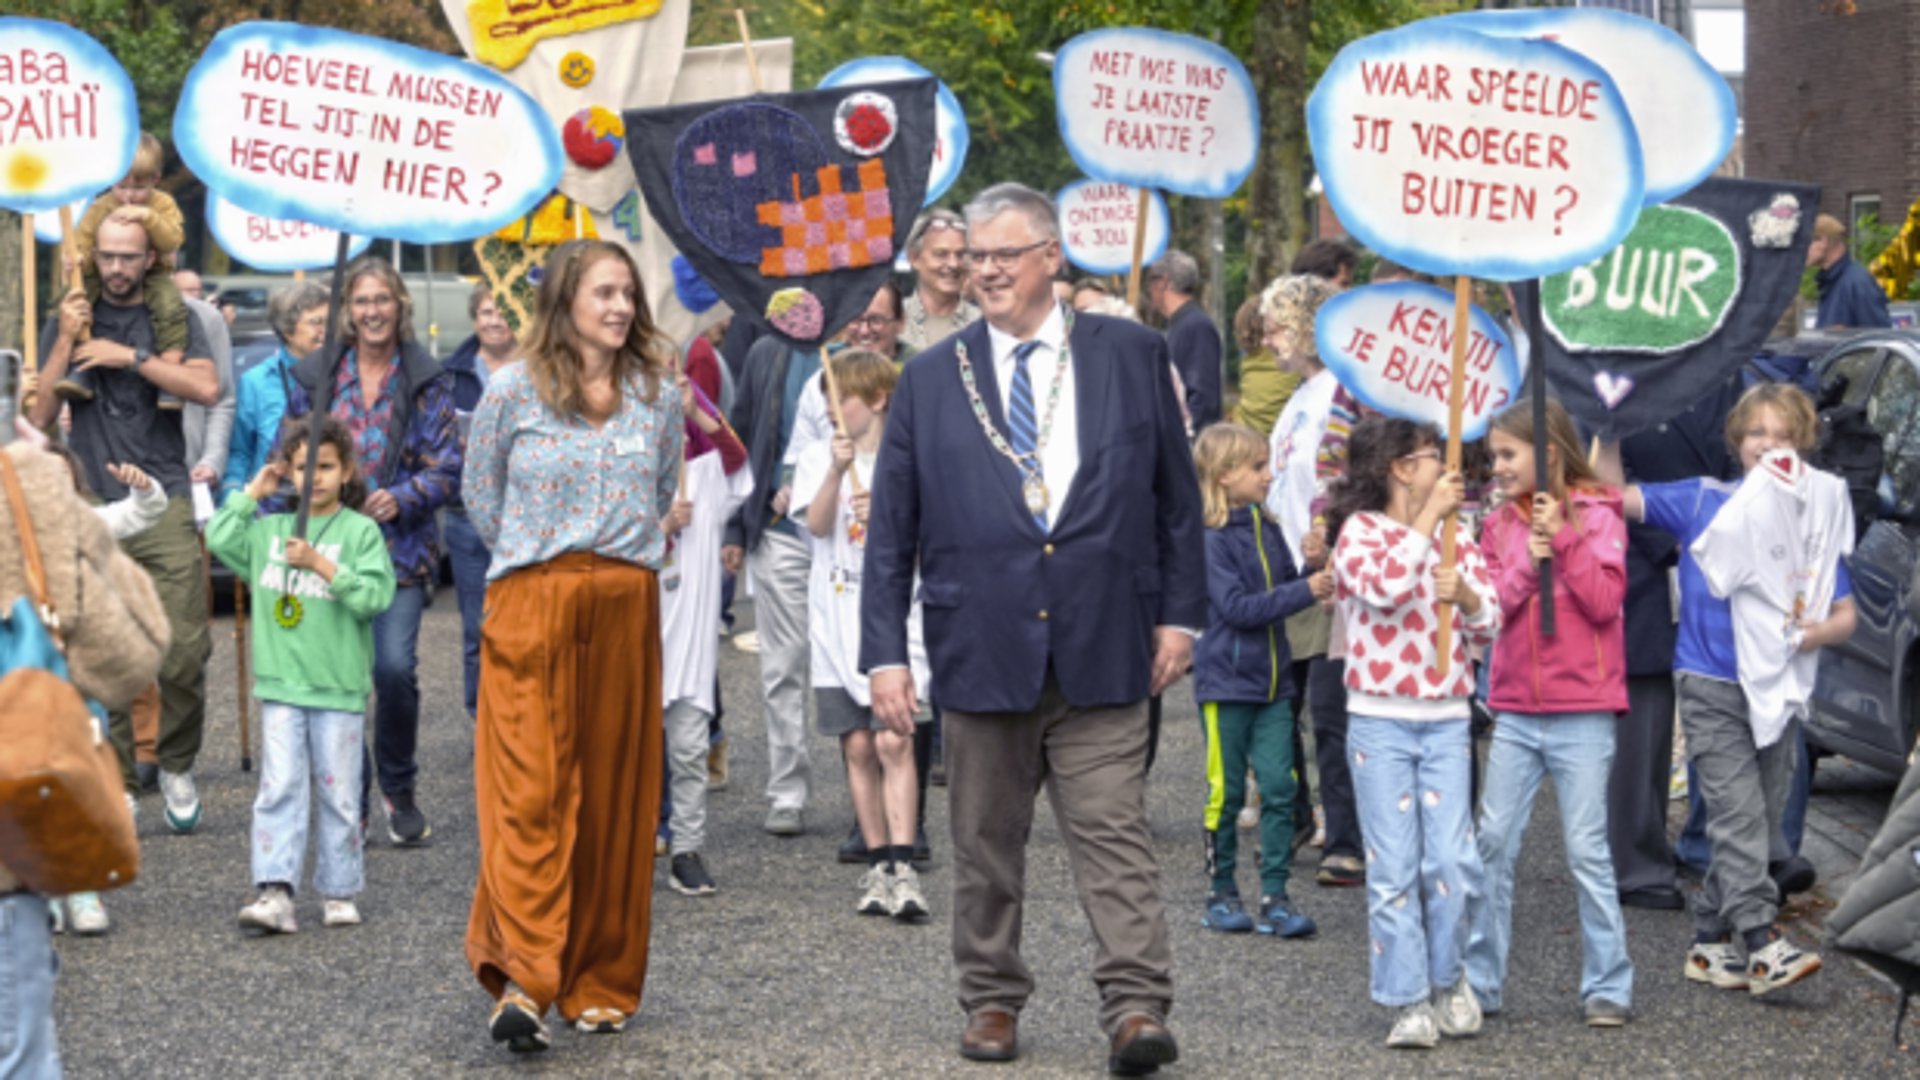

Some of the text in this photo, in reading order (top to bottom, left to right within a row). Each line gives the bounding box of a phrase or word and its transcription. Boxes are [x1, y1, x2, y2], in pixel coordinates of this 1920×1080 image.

[241, 49, 502, 118] HOEVEEL MUSSEN
[1090, 50, 1227, 90] MET WIE WAS
[1361, 60, 1602, 121] WAAR SPEELDE
[240, 92, 455, 151] TEL JIJ IN DE
[1091, 82, 1211, 122] JE LAATSTE
[1104, 117, 1191, 152] PRAATJE
[1352, 114, 1570, 171] JIJ VROEGER
[231, 135, 502, 206] HEGGEN HIER ?
[612, 190, 641, 242] 4
[1402, 170, 1579, 236] BUITEN ?
[1388, 300, 1456, 354] KEN
[1341, 326, 1378, 363] JE
[1383, 345, 1489, 416] BURN
